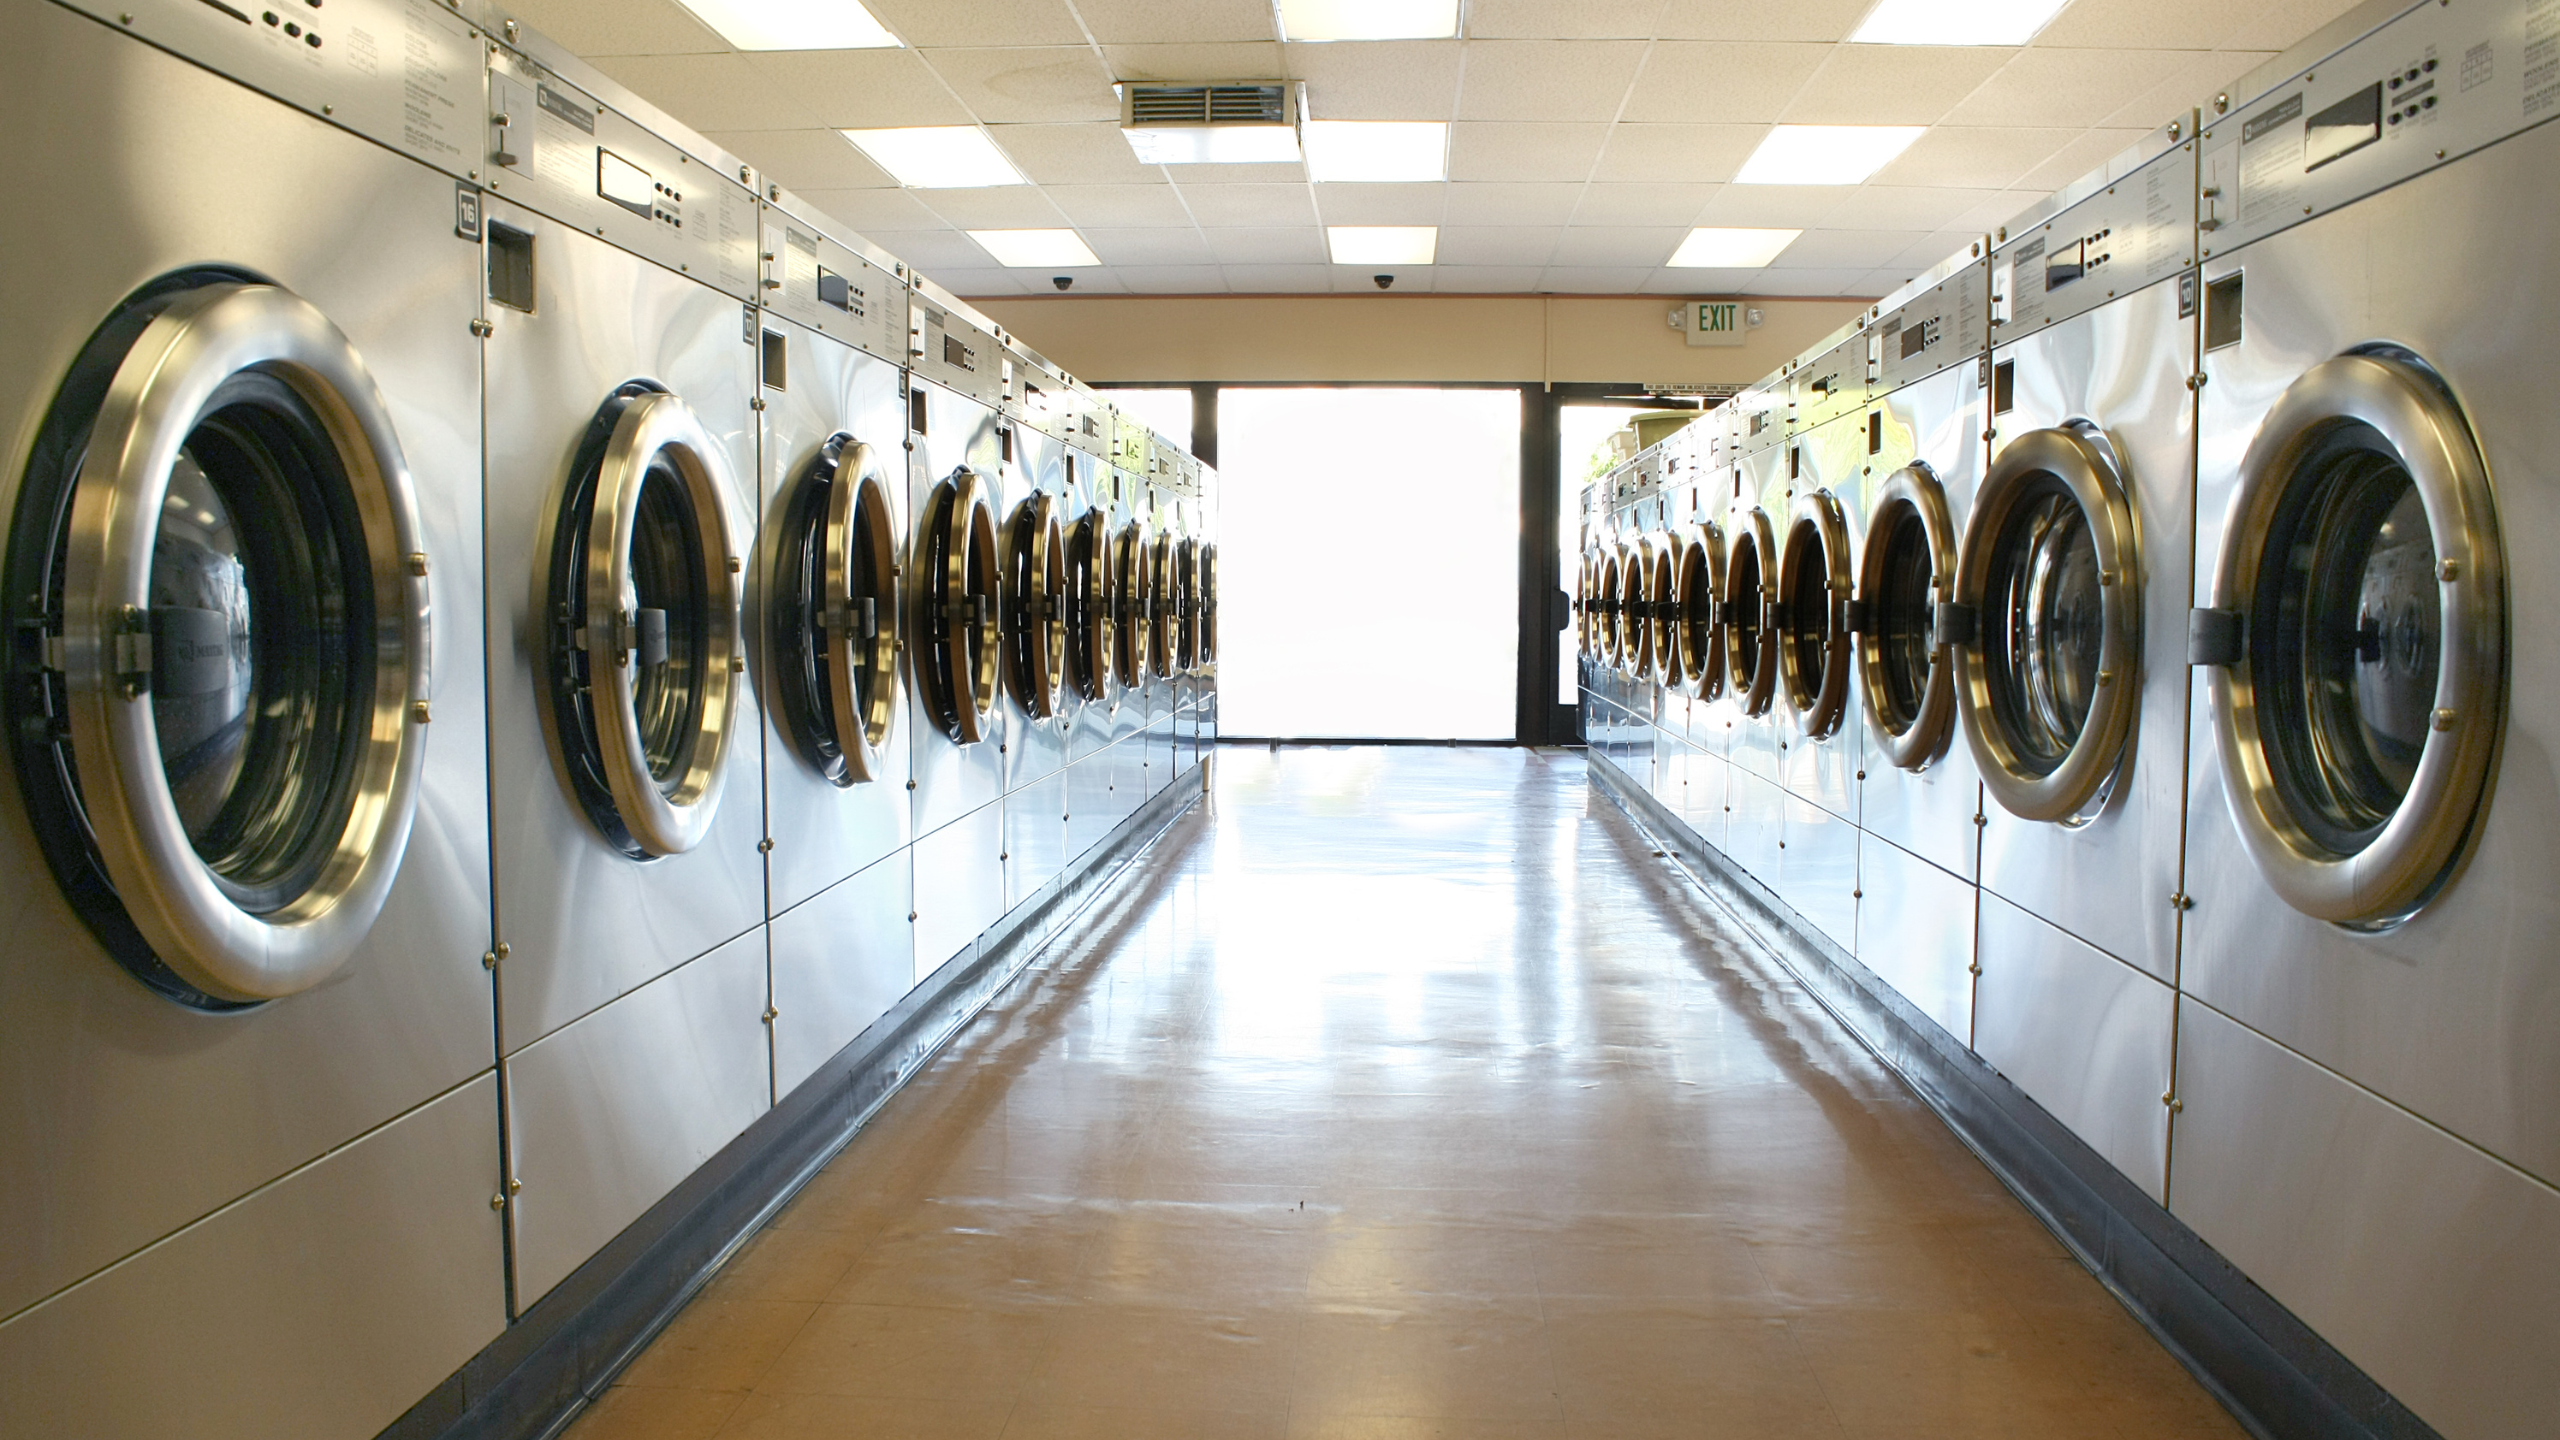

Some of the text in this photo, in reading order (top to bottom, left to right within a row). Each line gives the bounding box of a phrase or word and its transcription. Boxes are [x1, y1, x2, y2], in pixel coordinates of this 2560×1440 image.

[462, 202, 475, 223] 16
[2182, 287, 2191, 304] 10
[1699, 305, 1736, 331] EXIT
